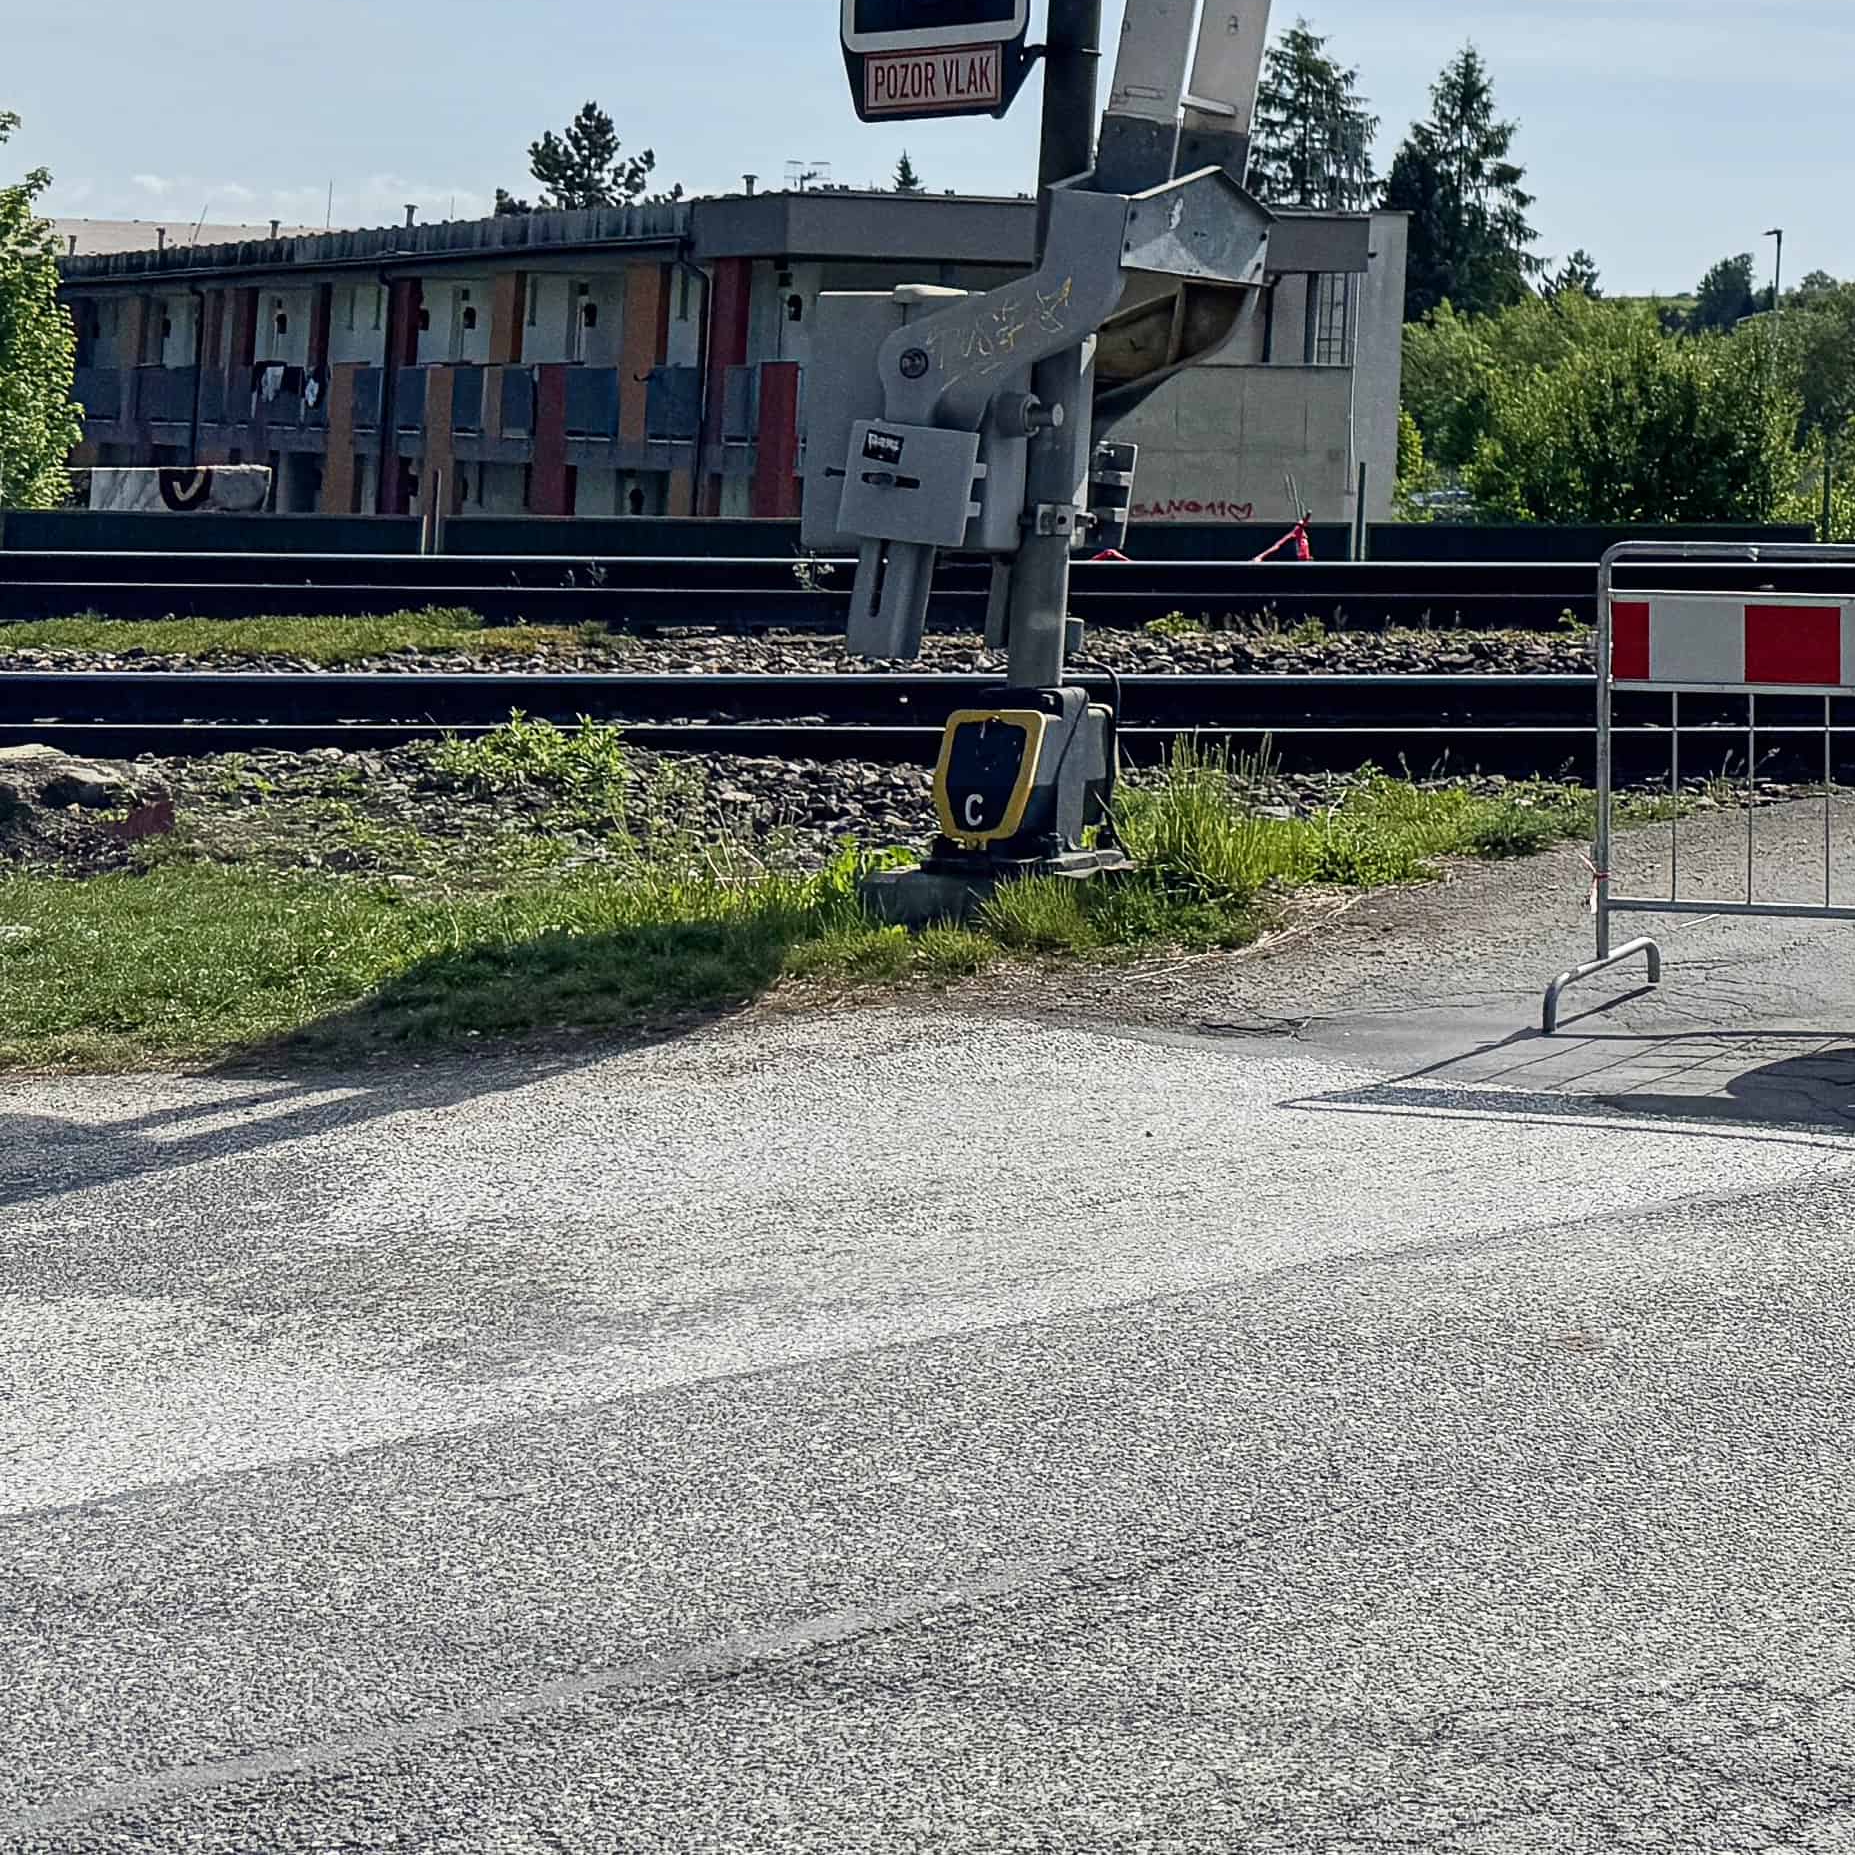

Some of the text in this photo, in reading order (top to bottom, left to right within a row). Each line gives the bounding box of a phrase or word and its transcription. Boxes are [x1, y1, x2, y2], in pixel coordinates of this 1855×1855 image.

[874, 55, 992, 102] POZOR VLAK
[964, 793, 984, 826] C
